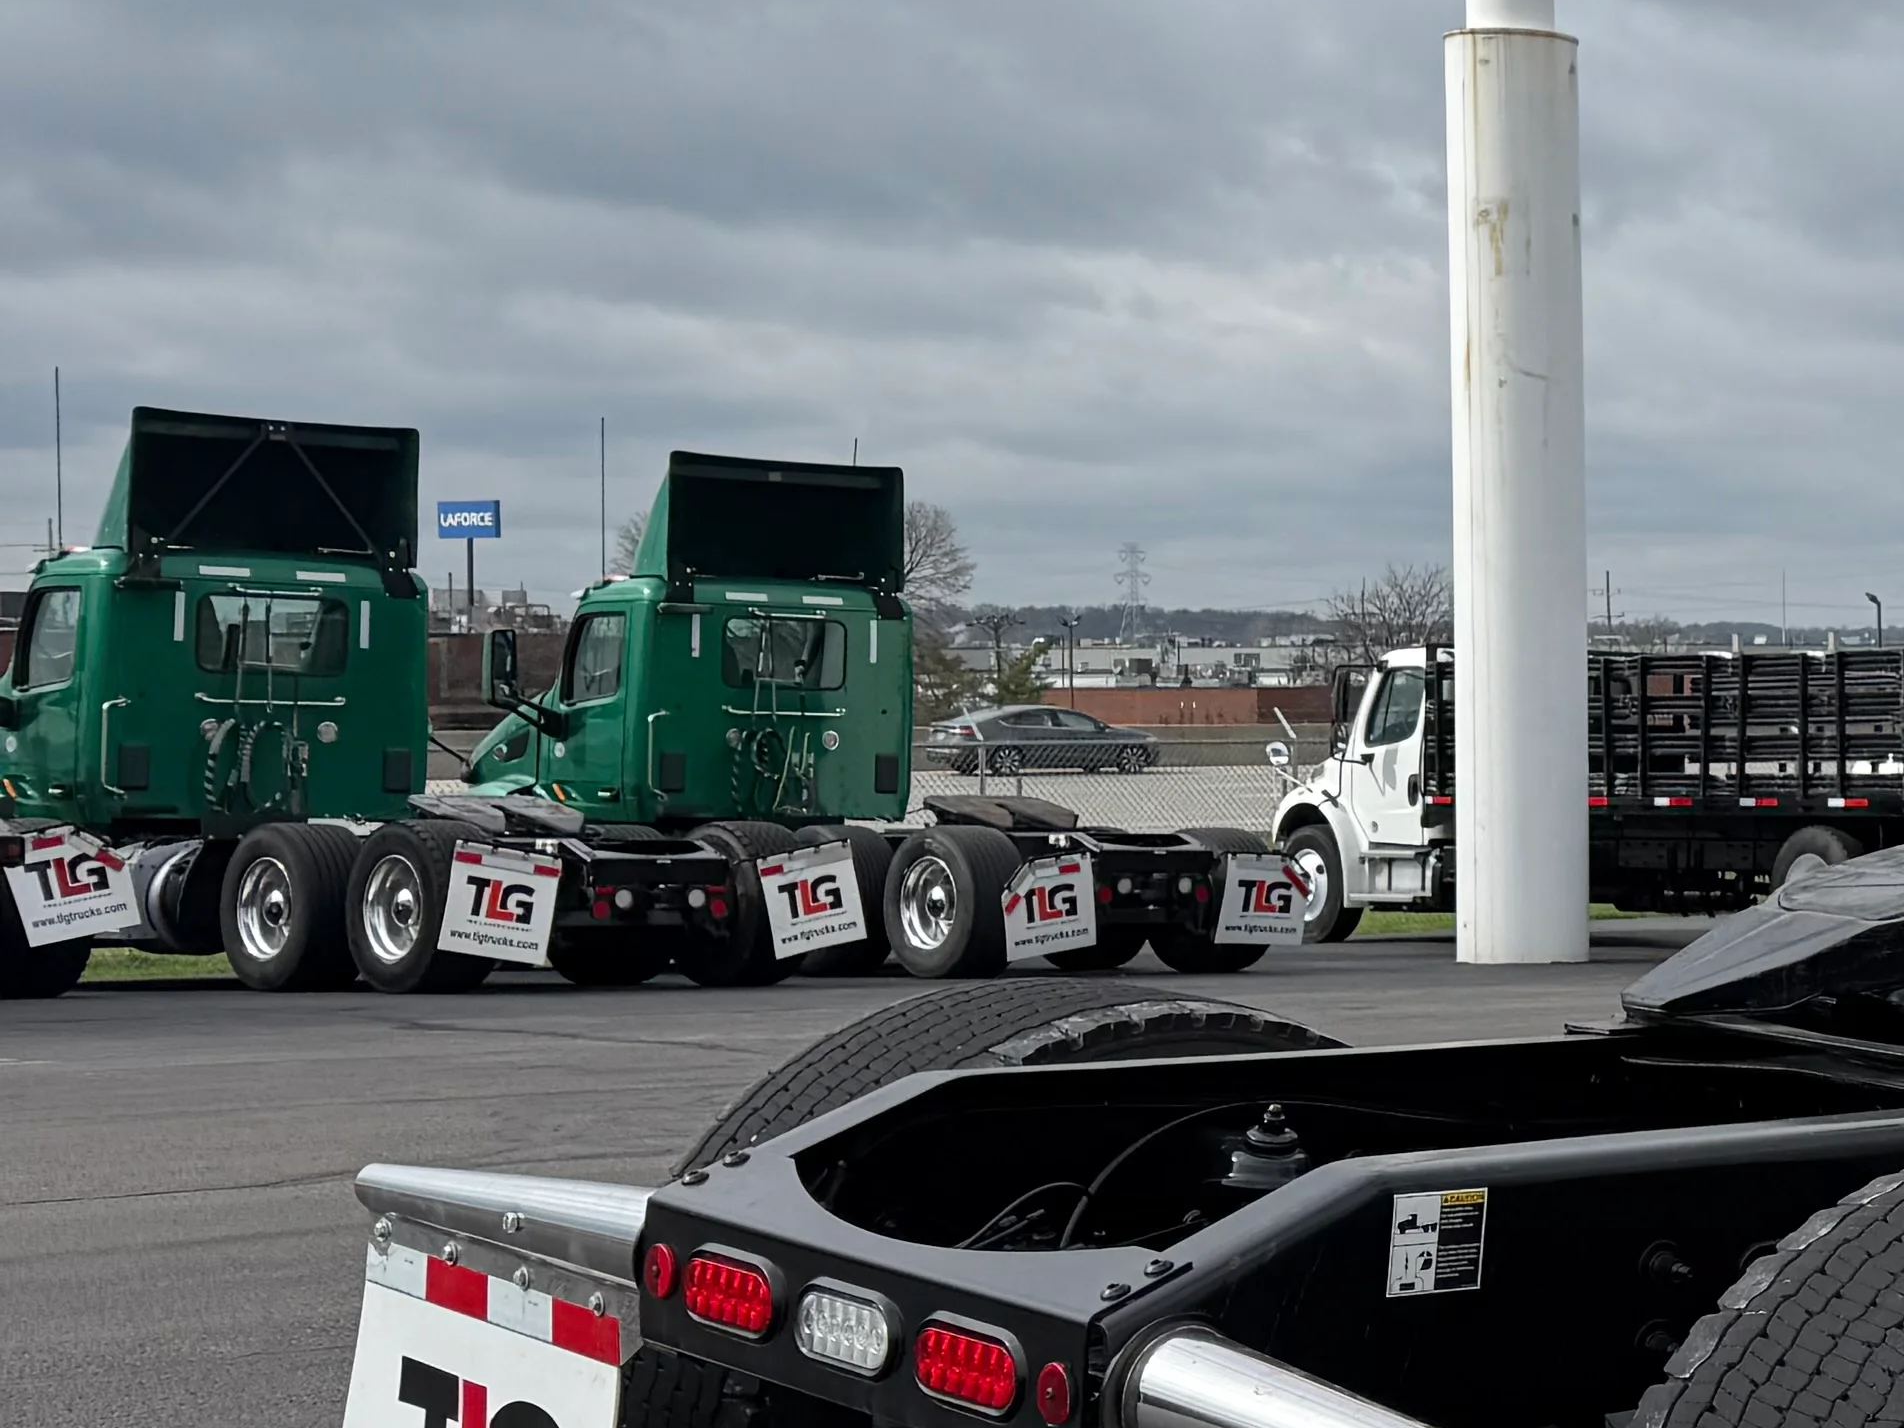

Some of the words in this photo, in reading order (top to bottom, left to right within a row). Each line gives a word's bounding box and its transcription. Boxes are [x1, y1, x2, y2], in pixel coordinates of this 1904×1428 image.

[440, 512, 494, 527] LAFORCE
[24, 852, 110, 901] TLG
[777, 874, 844, 920] TLG
[1238, 879, 1293, 914] TLG
[466, 875, 535, 925] TLG
[1023, 883, 1078, 924] TLG
